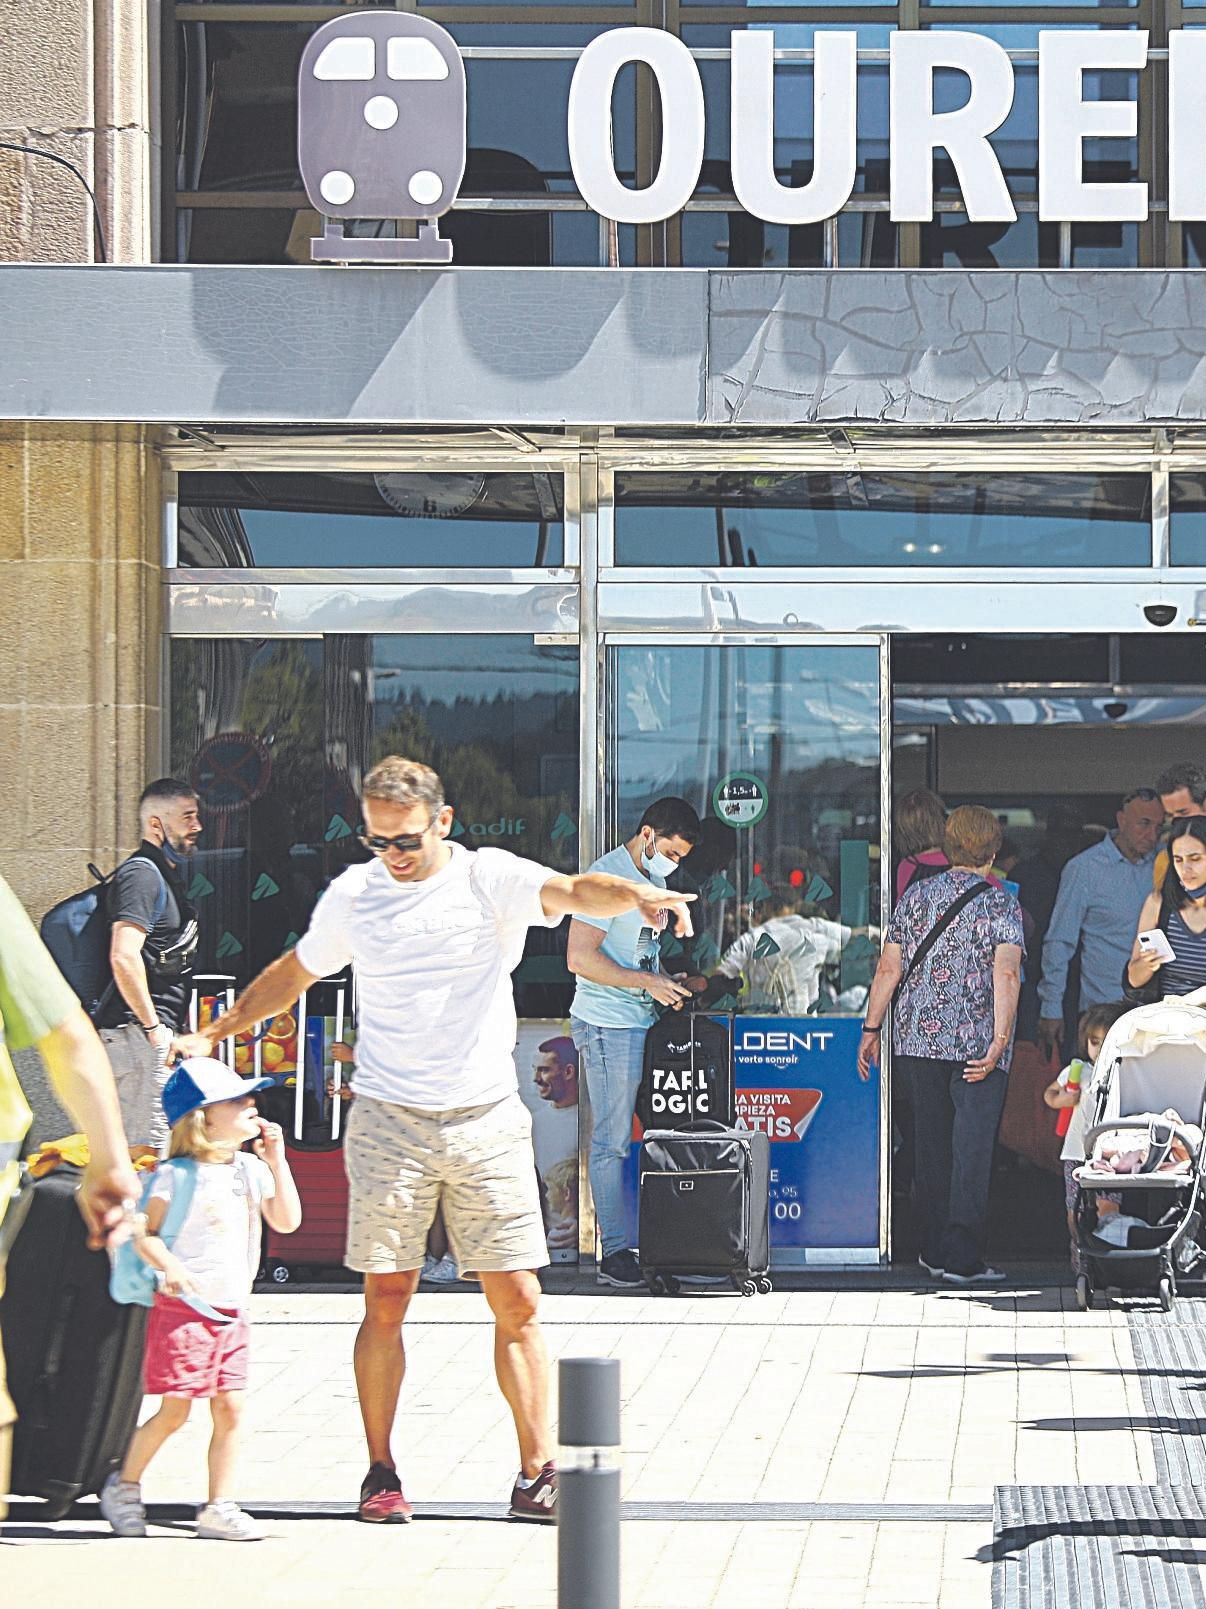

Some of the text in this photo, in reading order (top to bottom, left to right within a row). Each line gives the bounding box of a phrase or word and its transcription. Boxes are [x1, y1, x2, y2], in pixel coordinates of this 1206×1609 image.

[468, 818, 526, 836] adif
[652, 1069, 708, 1091] TARL
[651, 1093, 709, 1114] OGIC
[750, 1094, 792, 1105] VISITA
[774, 1202, 802, 1220] 00
